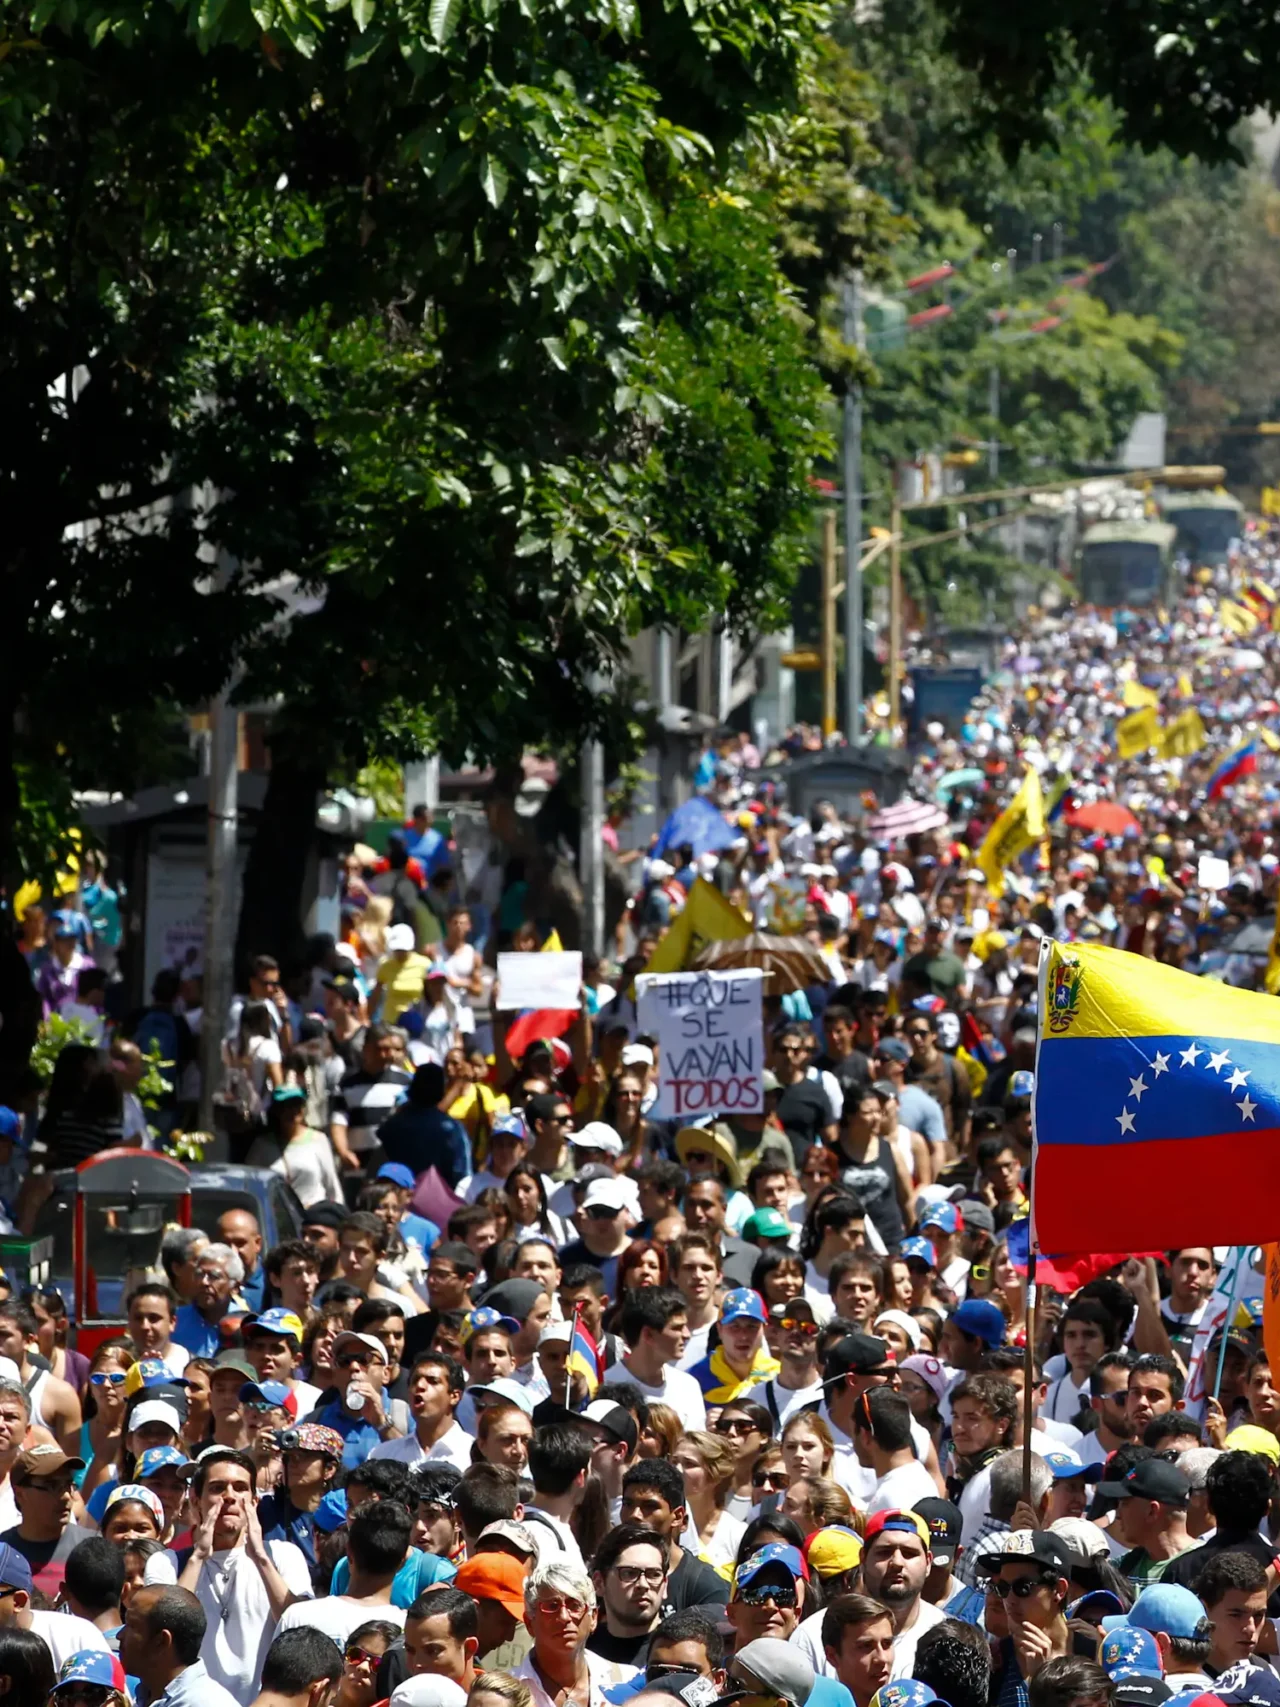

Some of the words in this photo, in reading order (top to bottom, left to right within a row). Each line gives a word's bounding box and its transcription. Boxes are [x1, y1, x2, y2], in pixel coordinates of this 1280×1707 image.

[659, 977, 752, 1008] #QUE
[681, 1010, 730, 1038] SE
[666, 1036, 754, 1079] VAYAN
[665, 1076, 760, 1114] TODOS
